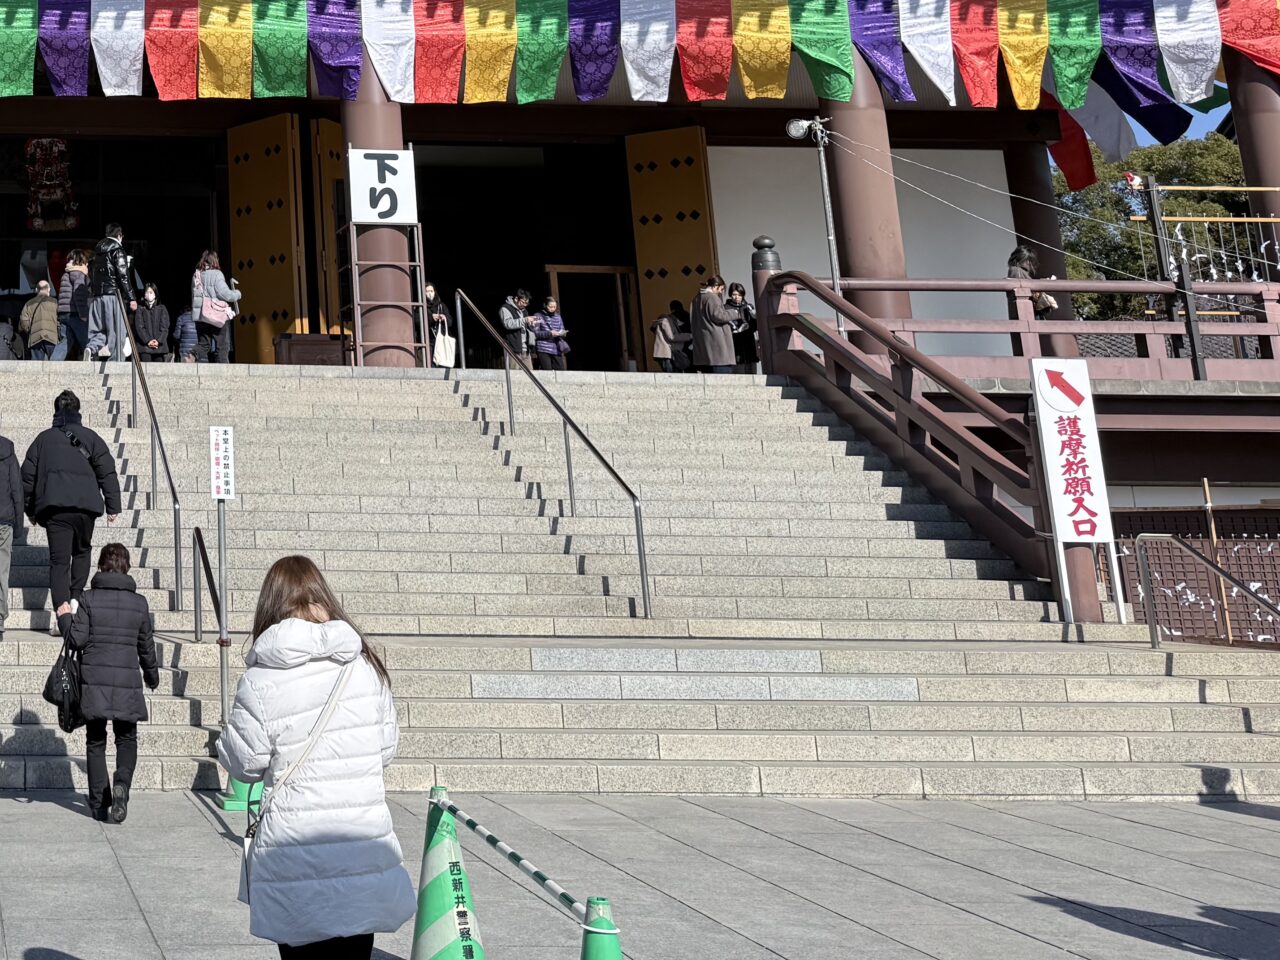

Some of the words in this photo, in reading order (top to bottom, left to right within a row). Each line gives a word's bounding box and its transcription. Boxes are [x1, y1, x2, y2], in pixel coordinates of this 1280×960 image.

[363, 152, 399, 219] 下り
[222, 429, 231, 496] 本堂上の禁止事項
[1054, 414, 1098, 537] 護摩祈願入口
[448, 860, 475, 960] 西新井警察署
